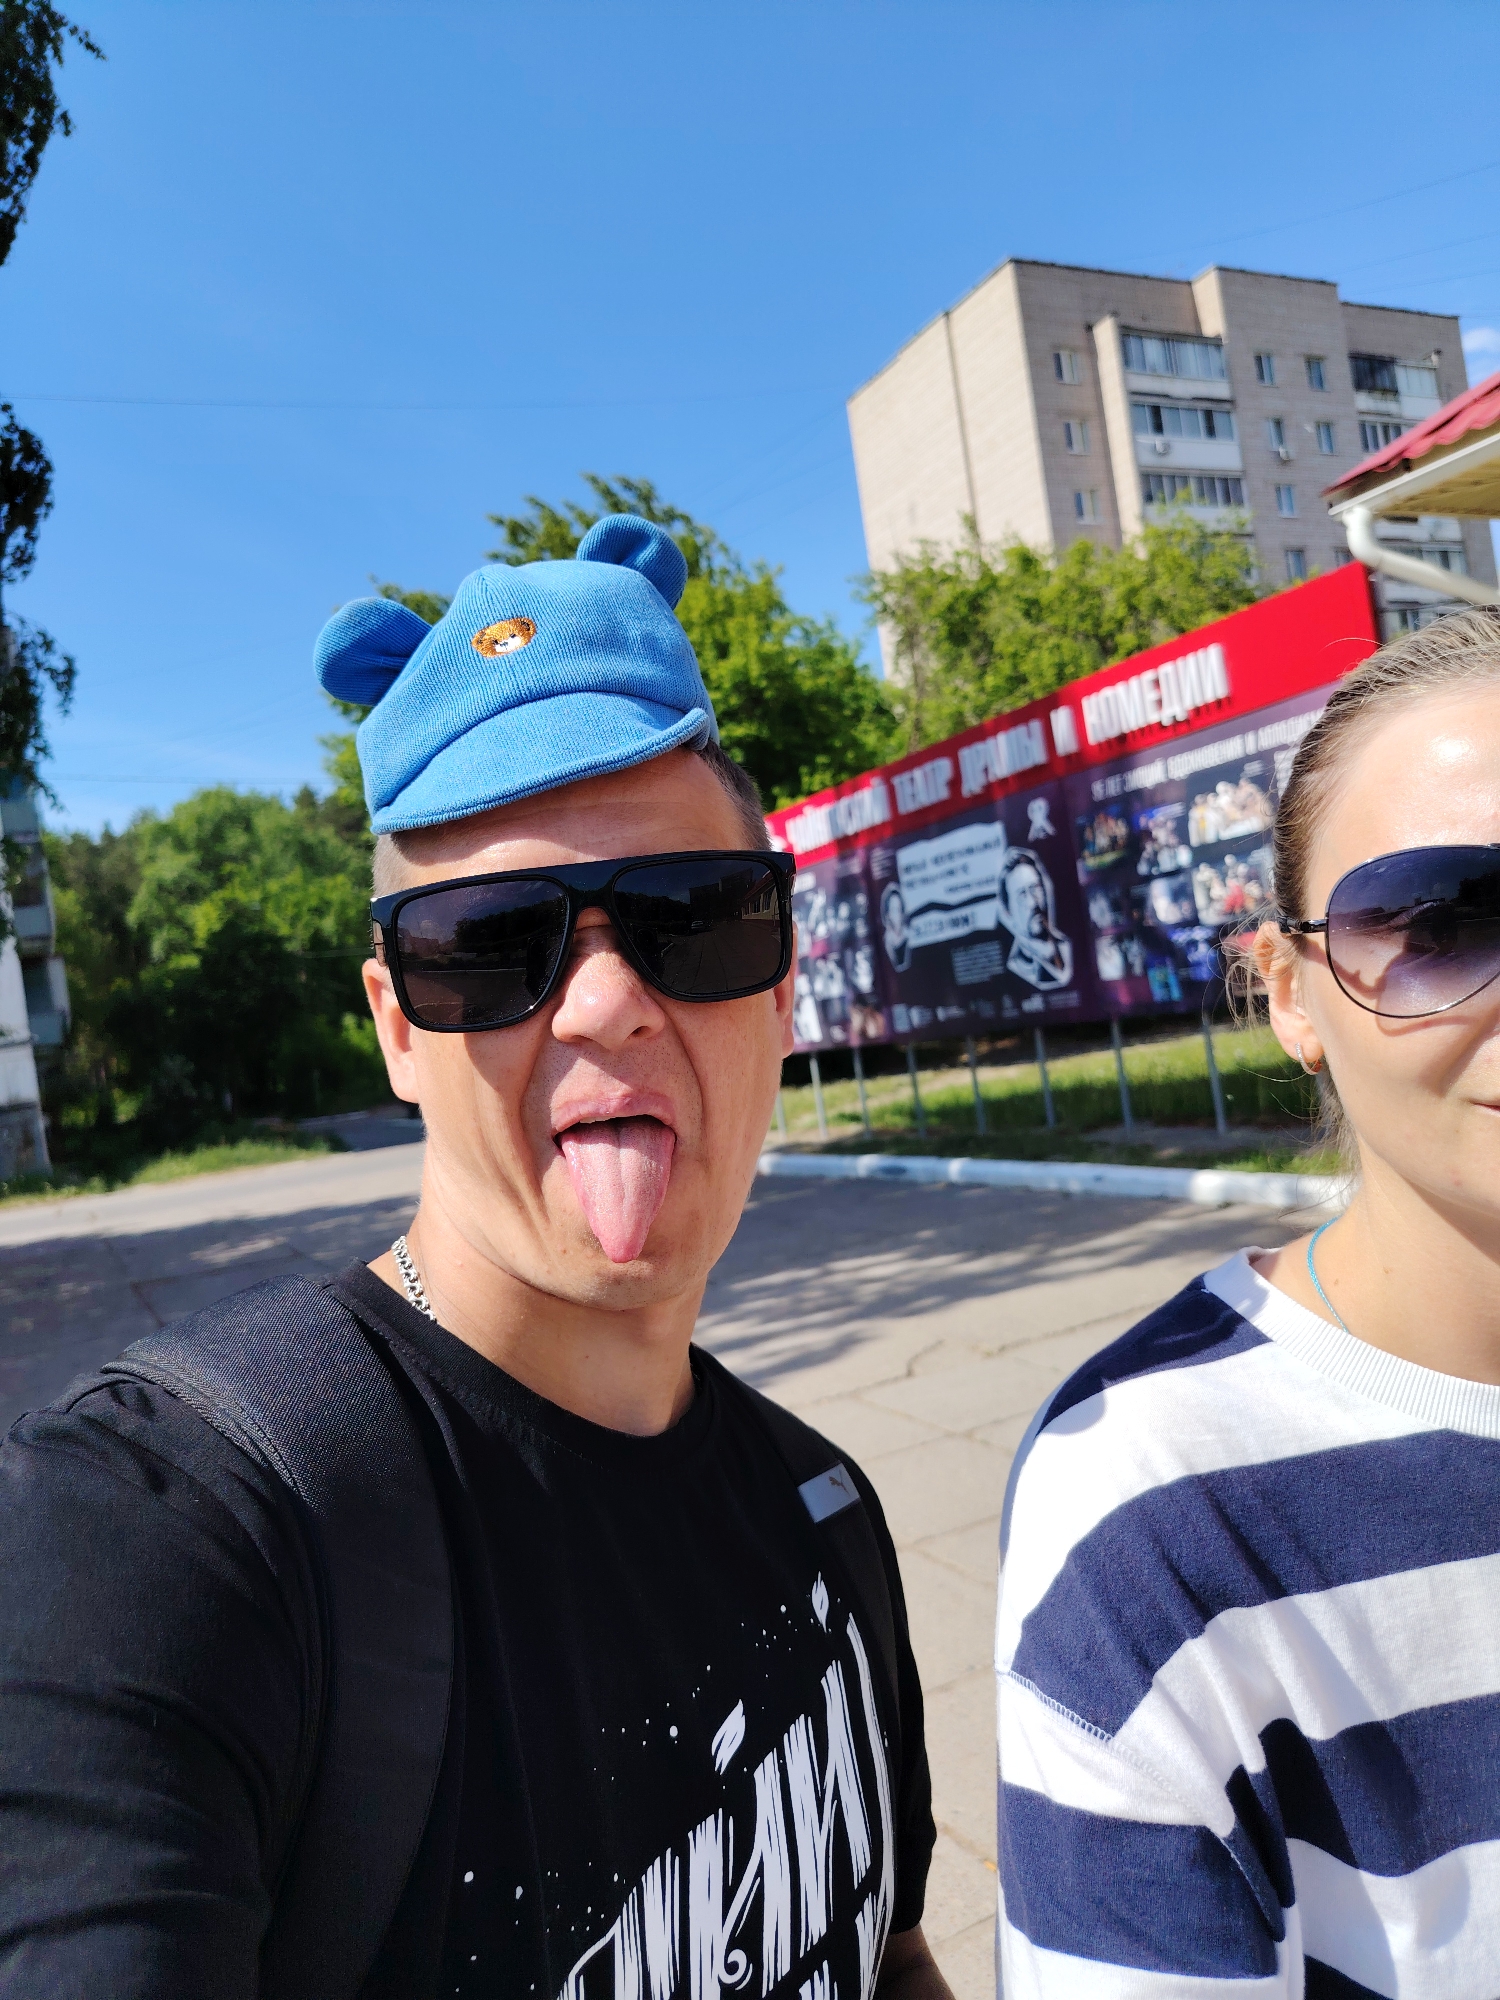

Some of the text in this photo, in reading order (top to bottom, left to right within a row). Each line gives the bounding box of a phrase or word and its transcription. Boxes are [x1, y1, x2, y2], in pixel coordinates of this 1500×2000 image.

[890, 756, 954, 816] ТЕАТР
[957, 718, 1047, 799] ДРАМЫ
[1050, 705, 1079, 757] И
[1081, 642, 1230, 746] КОМЕДИИ
